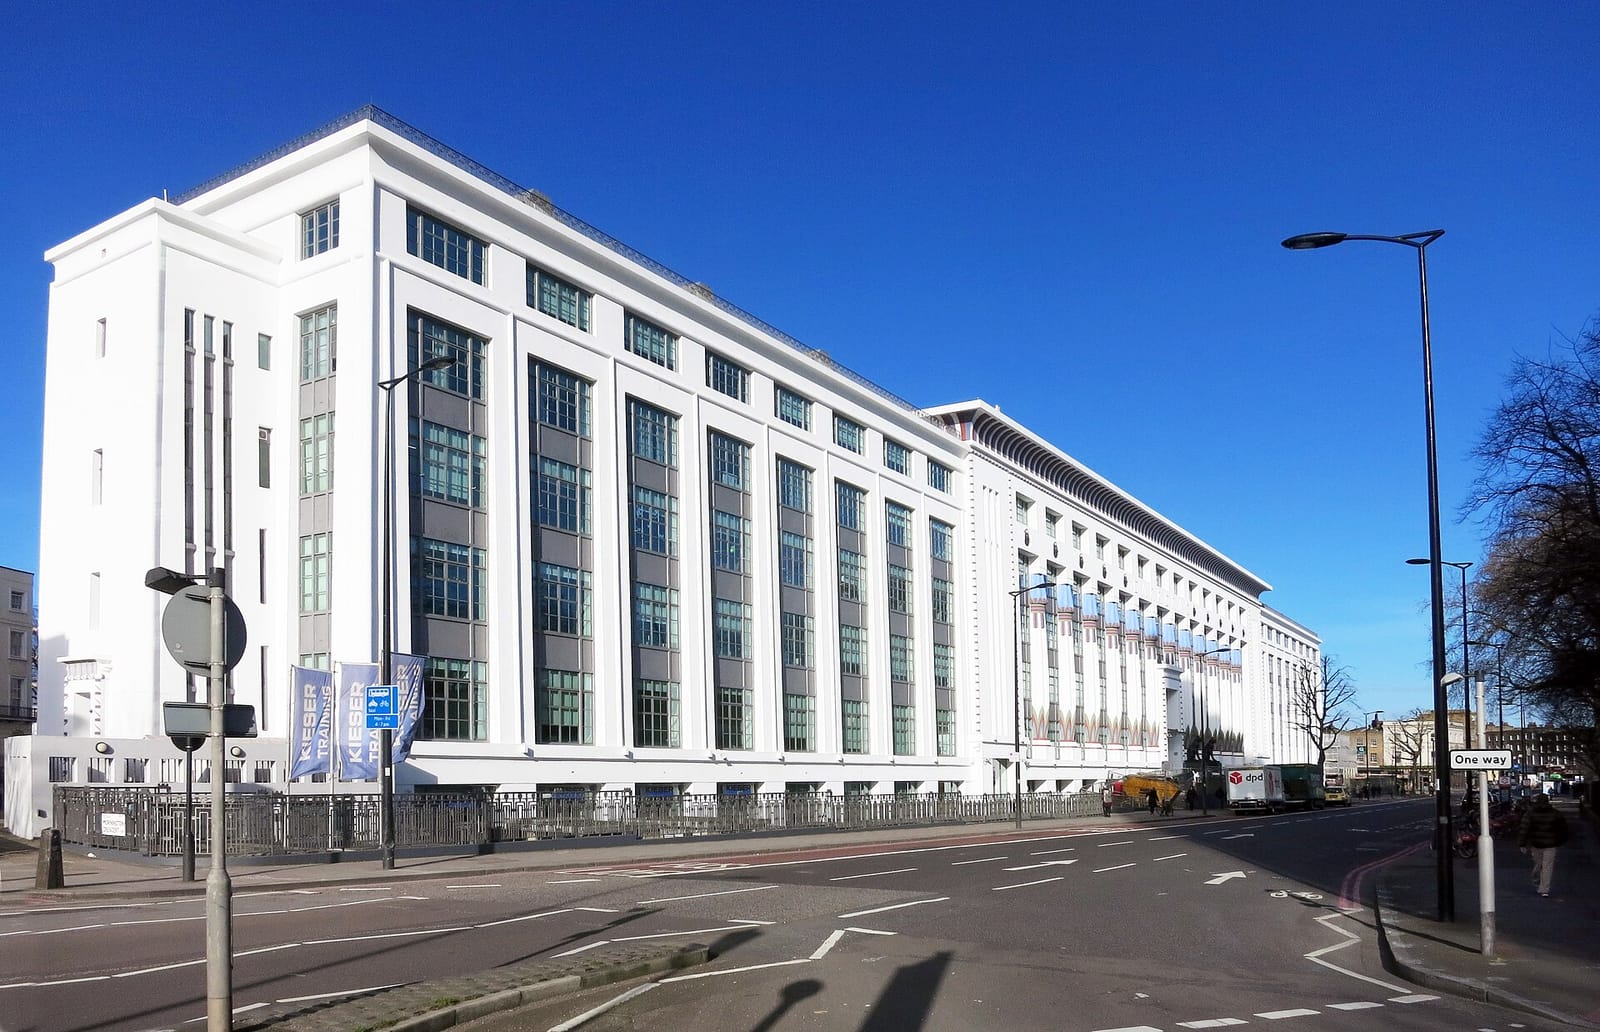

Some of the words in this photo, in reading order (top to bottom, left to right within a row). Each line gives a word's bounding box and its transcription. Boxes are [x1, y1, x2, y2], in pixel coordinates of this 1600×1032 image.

[299, 683, 317, 762] KIESER
[317, 686, 332, 760] TRAINING
[348, 682, 364, 763] KIESER
[1246, 773, 1263, 783] dpd
[1455, 755, 1478, 764] One
[1483, 757, 1507, 766] way
